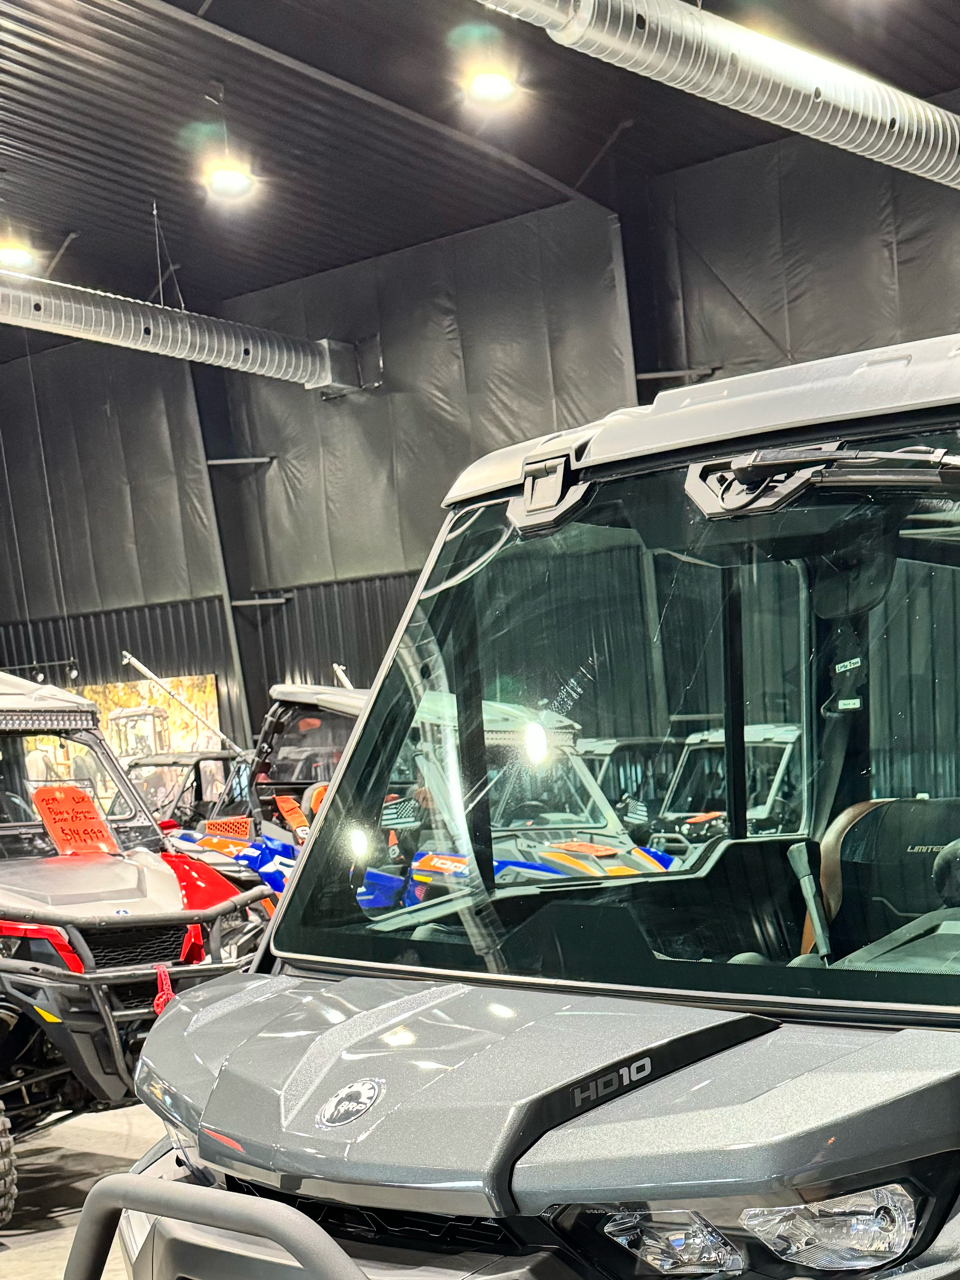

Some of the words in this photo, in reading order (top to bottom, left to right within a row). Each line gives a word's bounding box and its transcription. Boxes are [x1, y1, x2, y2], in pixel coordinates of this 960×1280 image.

[60, 826, 105, 846] $14,999
[574, 1056, 652, 1108] HD10
[337, 1100, 367, 1114] BRP
